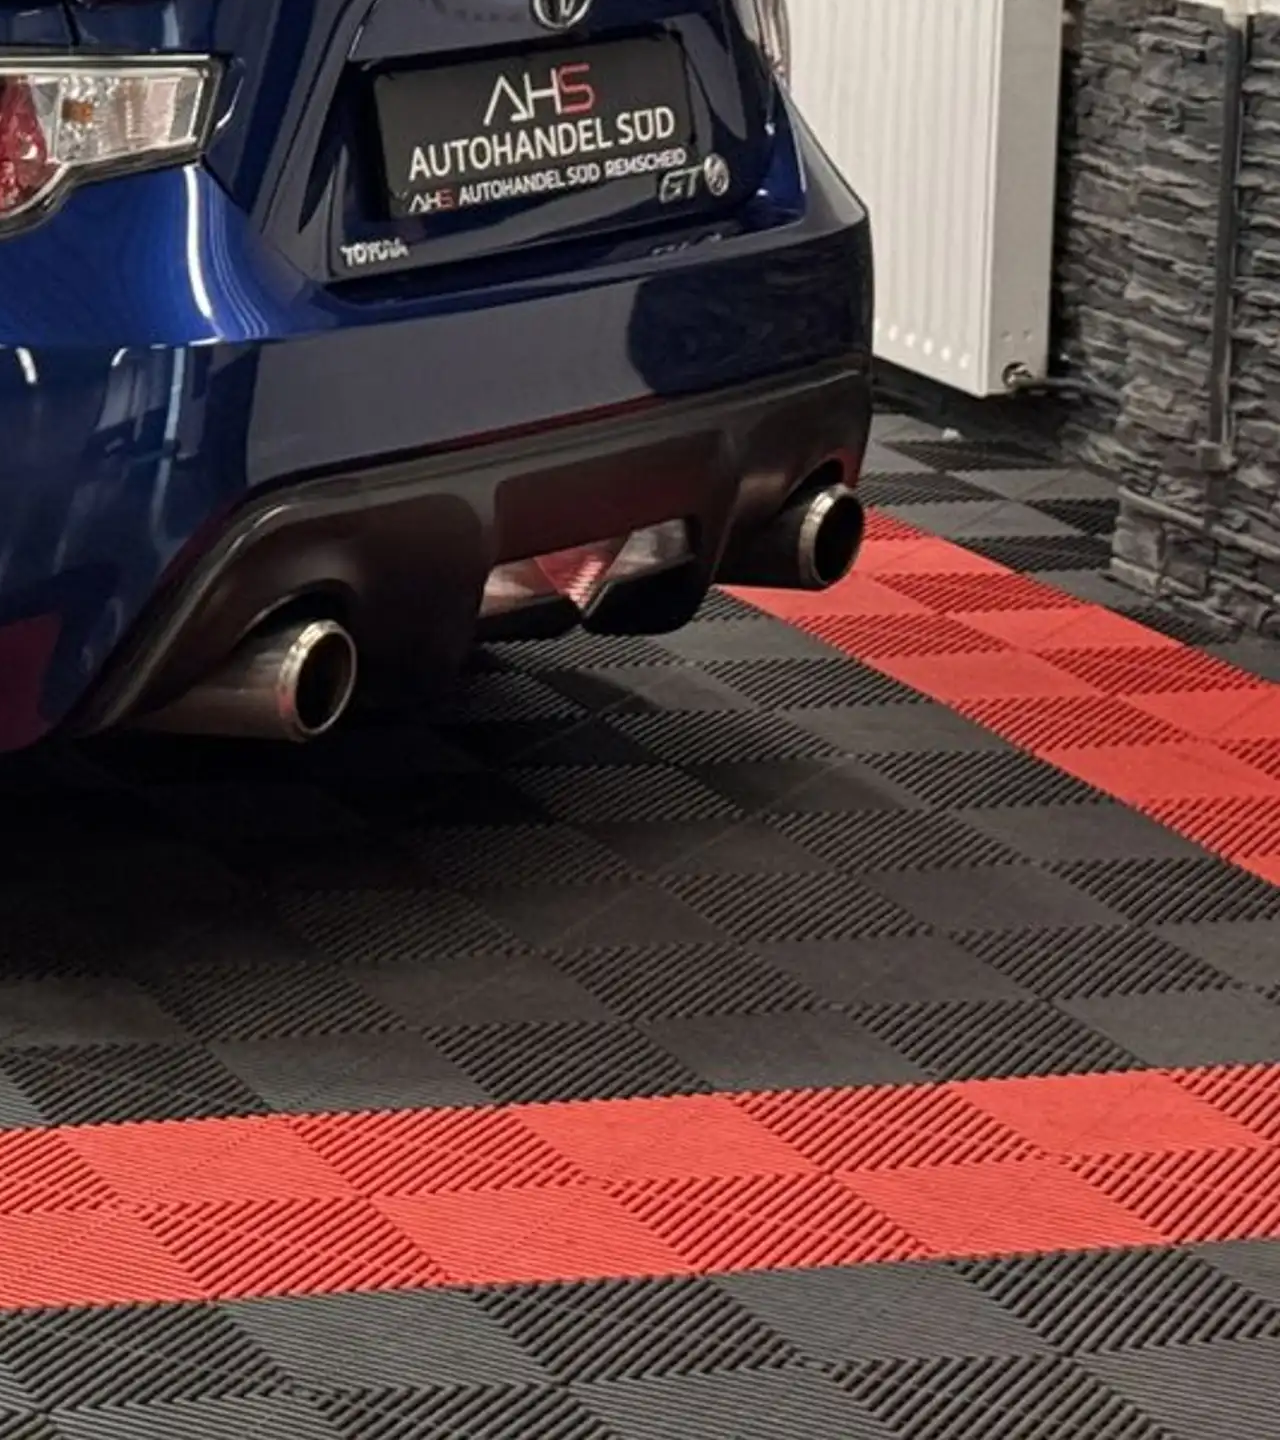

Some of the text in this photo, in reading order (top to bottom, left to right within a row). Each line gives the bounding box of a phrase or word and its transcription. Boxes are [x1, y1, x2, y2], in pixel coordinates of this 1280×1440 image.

[483, 63, 596, 126] AHS
[408, 106, 676, 182] AUTOHANDEL SÜD
[458, 170, 565, 206] AUTOHANDEL
